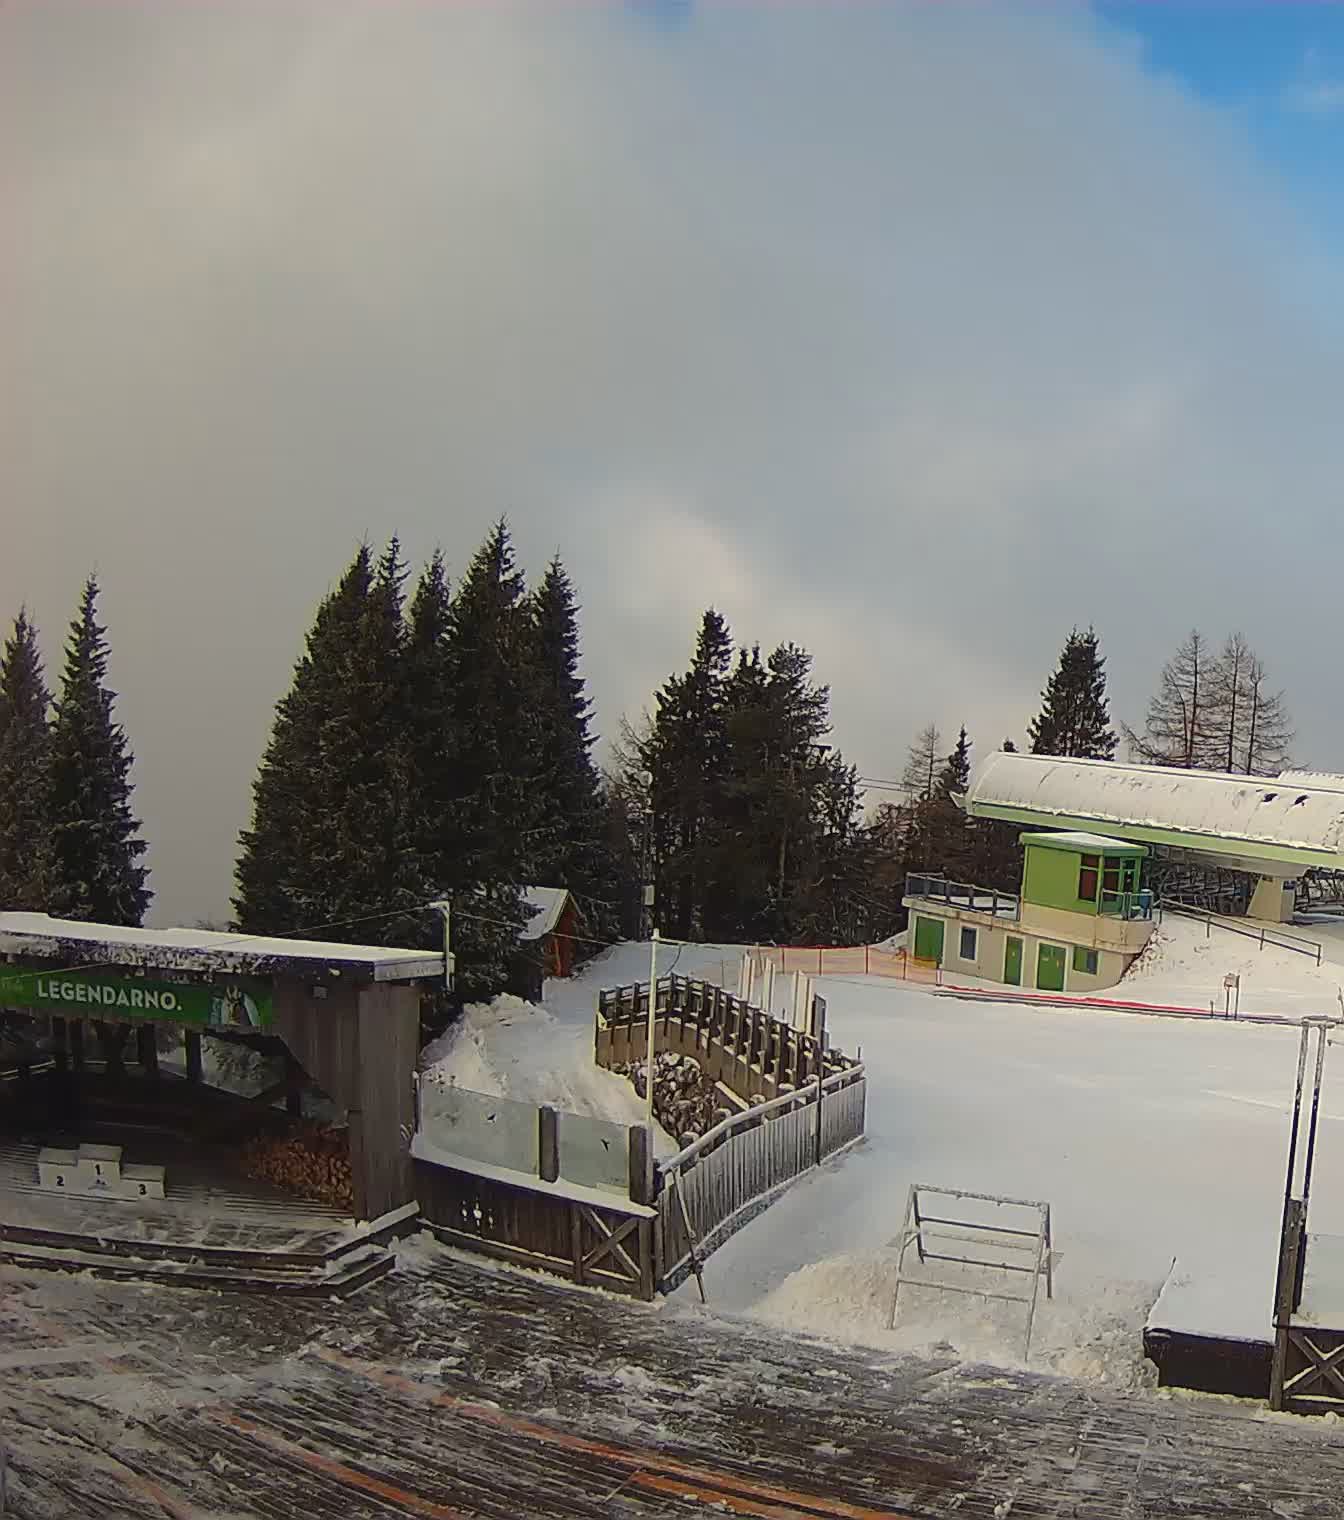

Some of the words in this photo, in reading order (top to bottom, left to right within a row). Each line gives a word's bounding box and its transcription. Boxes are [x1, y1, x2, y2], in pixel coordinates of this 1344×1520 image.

[38, 979, 183, 1011] LEGENDARNO.
[56, 1176, 64, 1187] 2
[138, 1184, 147, 1195] 3
